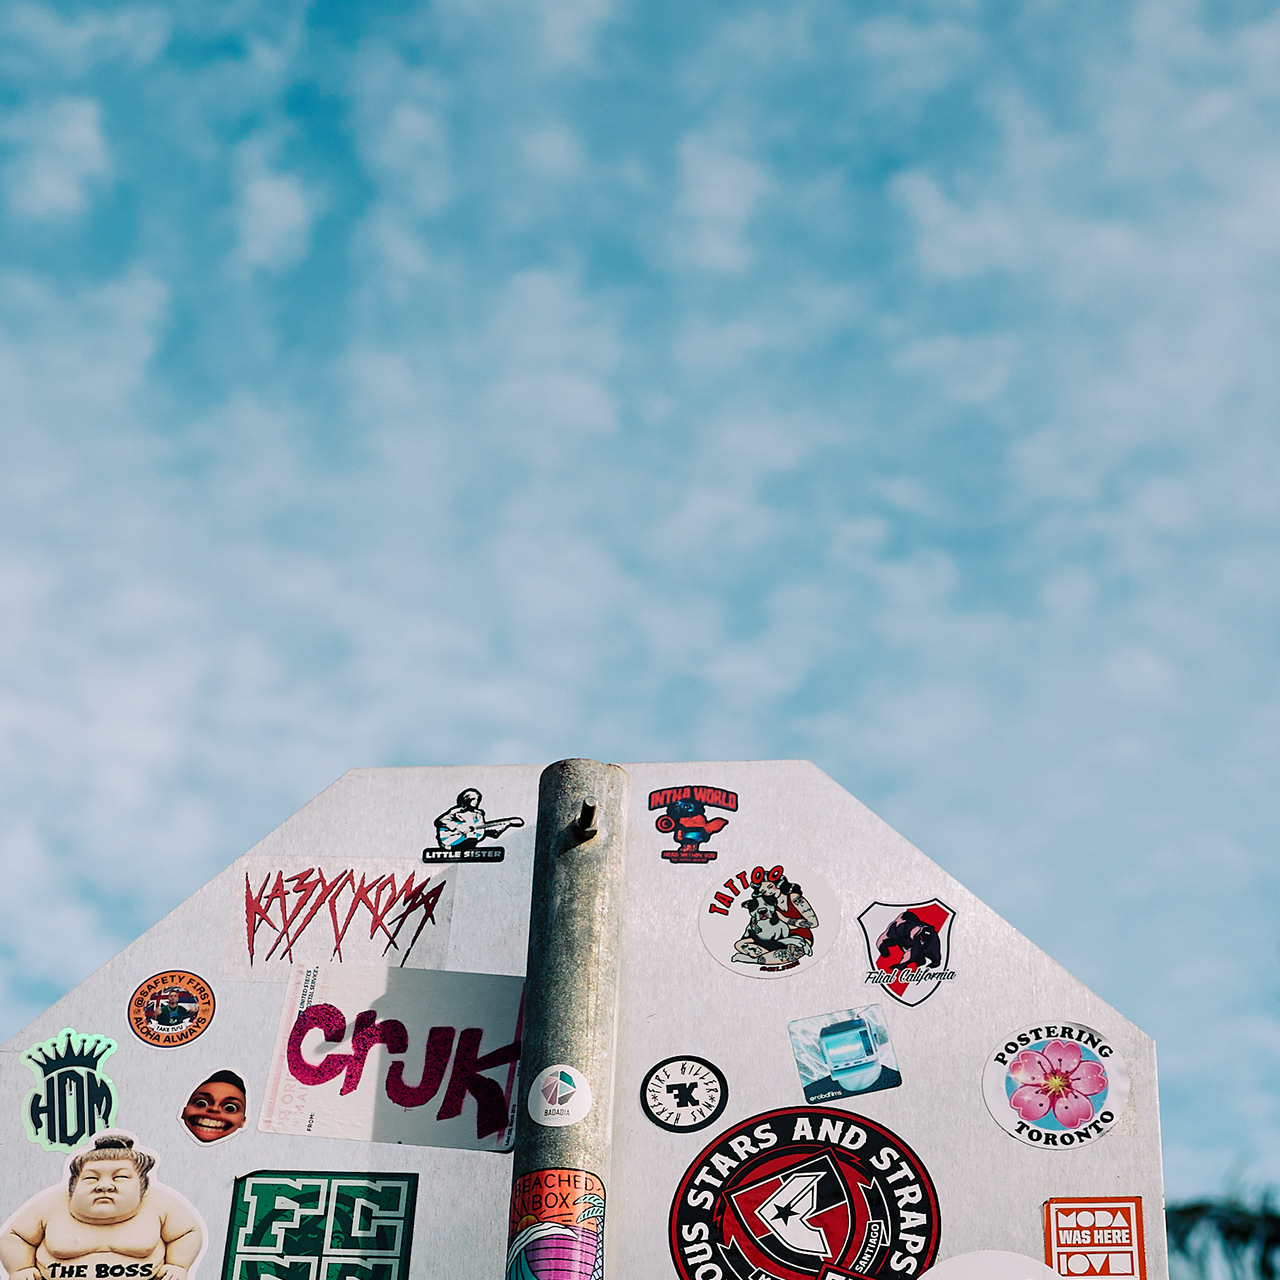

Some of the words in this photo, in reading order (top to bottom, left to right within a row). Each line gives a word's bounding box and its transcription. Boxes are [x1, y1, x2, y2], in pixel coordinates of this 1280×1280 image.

[693, 787, 737, 809] WORLD
[425, 851, 461, 859] LITTLE
[463, 850, 502, 858] SISTER
[708, 865, 784, 916] TATTOO
[899, 968, 957, 986] California
[134, 975, 186, 1008] @SAFETY
[186, 978, 211, 1006] FIRST
[134, 1016, 161, 1043] ALOHA
[162, 1016, 207, 1044] ALWAYS
[994, 1025, 1114, 1066] POSTERING
[1015, 1110, 1115, 1147] TORONTO
[515, 1173, 595, 1198] BEACHED
[686, 1122, 778, 1210] STARS
[792, 1117, 868, 1150] AND
[869, 1147, 927, 1276] STRAPS
[532, 1192, 570, 1209] BOX
[1057, 1210, 1129, 1228] MODA
[854, 1223, 880, 1273] SANTIAGO
[1058, 1229, 1092, 1245] WAS
[1093, 1229, 1131, 1244] HERE
[47, 1262, 88, 1279] THE
[95, 1263, 154, 1279] BOSS
